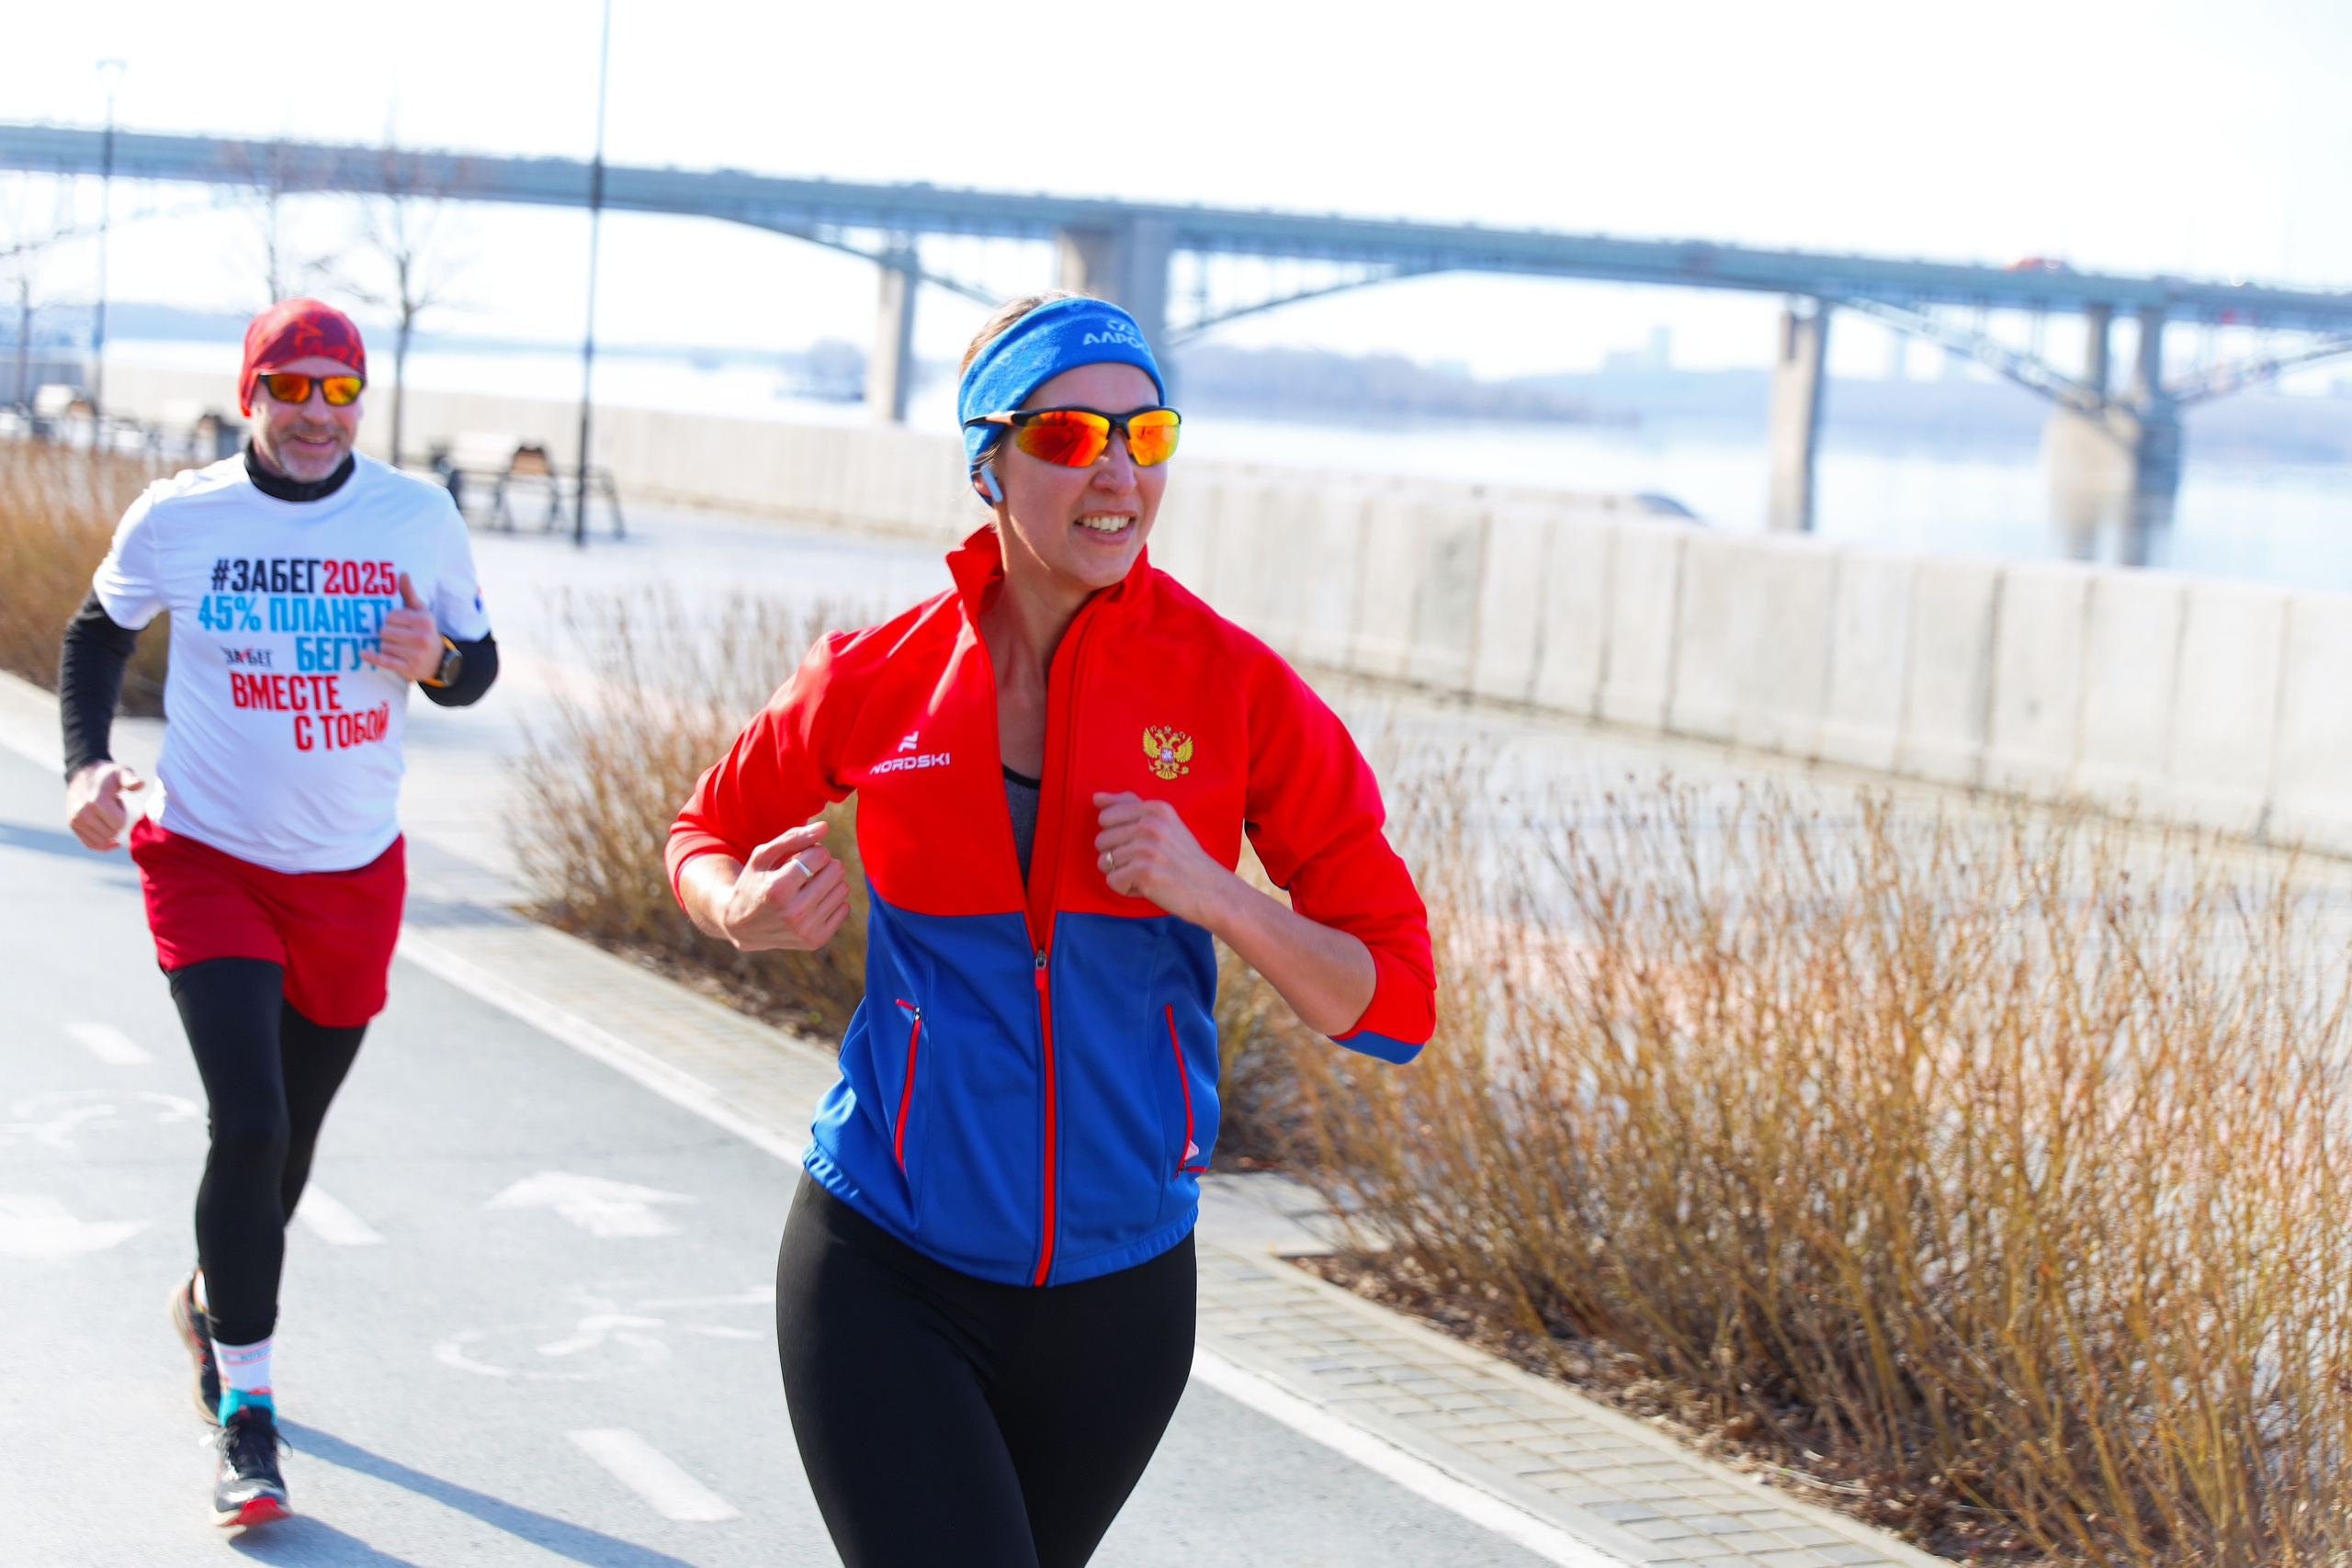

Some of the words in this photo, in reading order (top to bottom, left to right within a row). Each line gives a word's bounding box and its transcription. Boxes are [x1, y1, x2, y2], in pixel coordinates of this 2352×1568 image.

[198, 595, 262, 631] 45%
[269, 597, 392, 633] ПЛАНЕТ
[230, 671, 342, 711] ВМЕСТЕ
[293, 715, 313, 751] С
[318, 701, 390, 750] ТОБОЙ
[869, 752, 950, 774] NORDSKI
